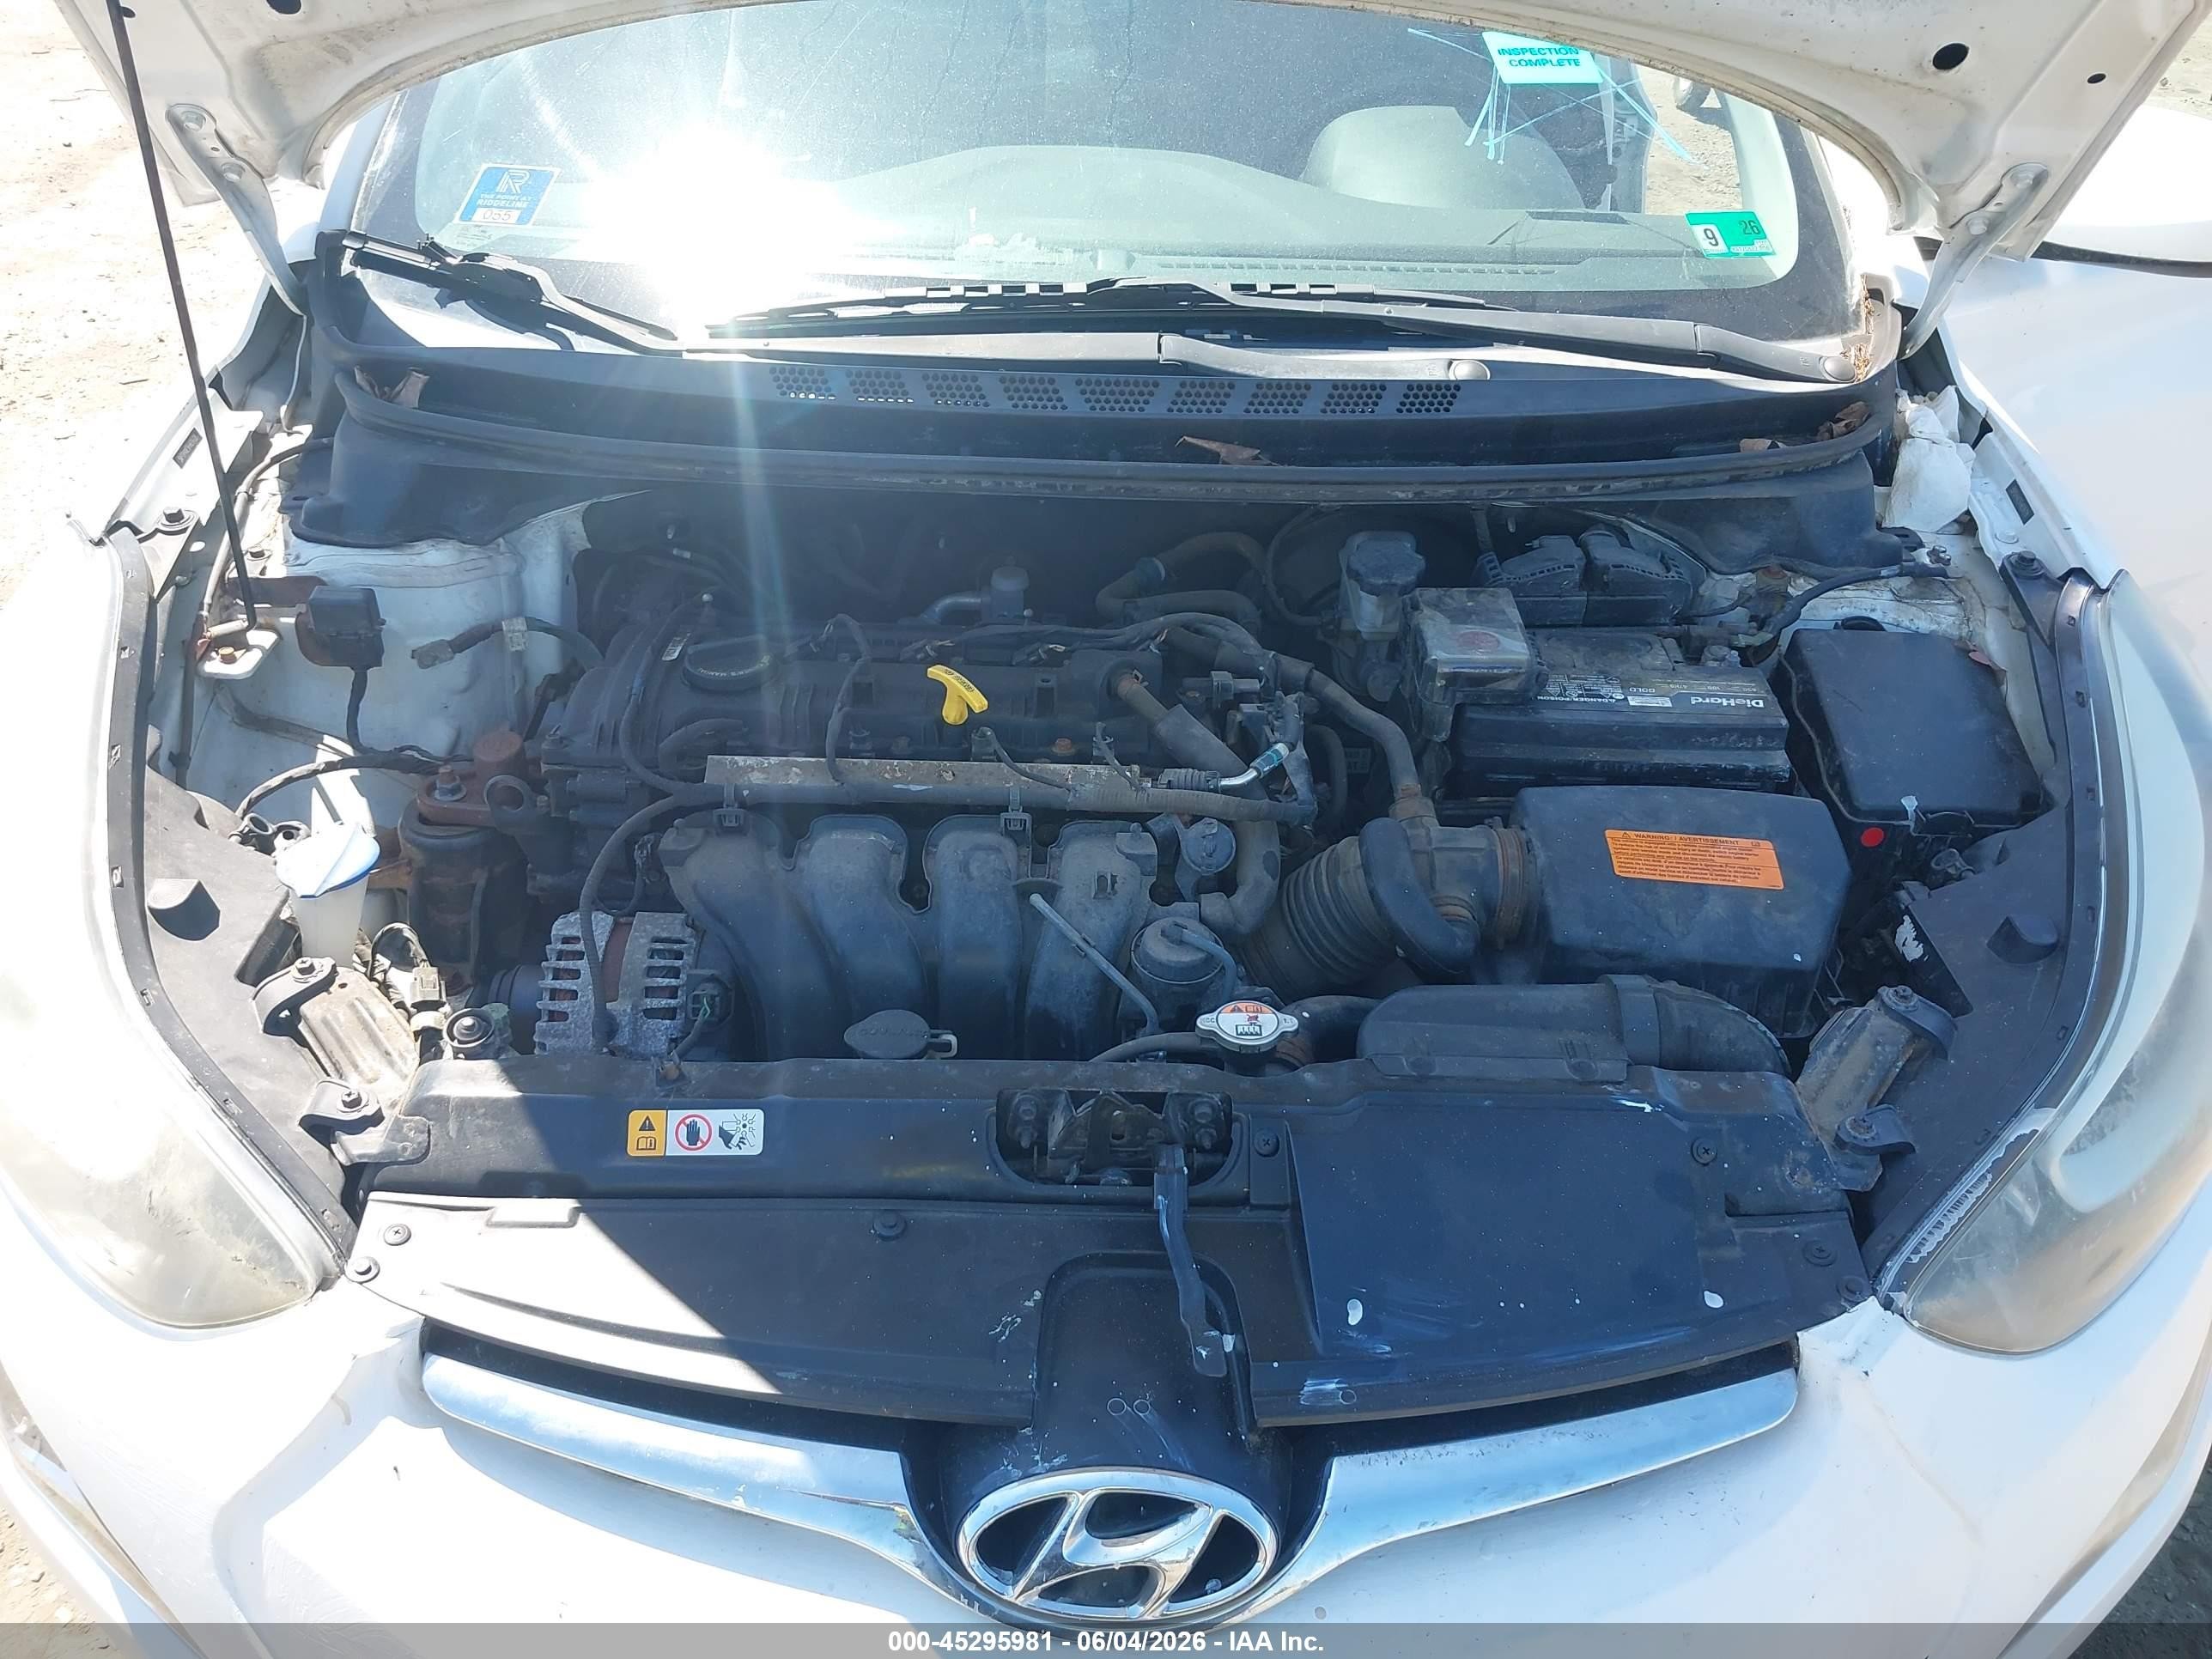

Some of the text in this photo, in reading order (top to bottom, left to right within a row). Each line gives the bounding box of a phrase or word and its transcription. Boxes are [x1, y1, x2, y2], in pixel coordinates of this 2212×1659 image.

[1498, 47, 1579, 56] INSPECTION
[476, 199, 531, 208] RIDGELINE
[483, 210, 512, 221] 055
[1739, 220, 1761, 234] 26
[1703, 228, 1719, 246] 9
[1690, 696, 1765, 708] DieHard
[1679, 836, 1740, 846] AVERTISSEMENT
